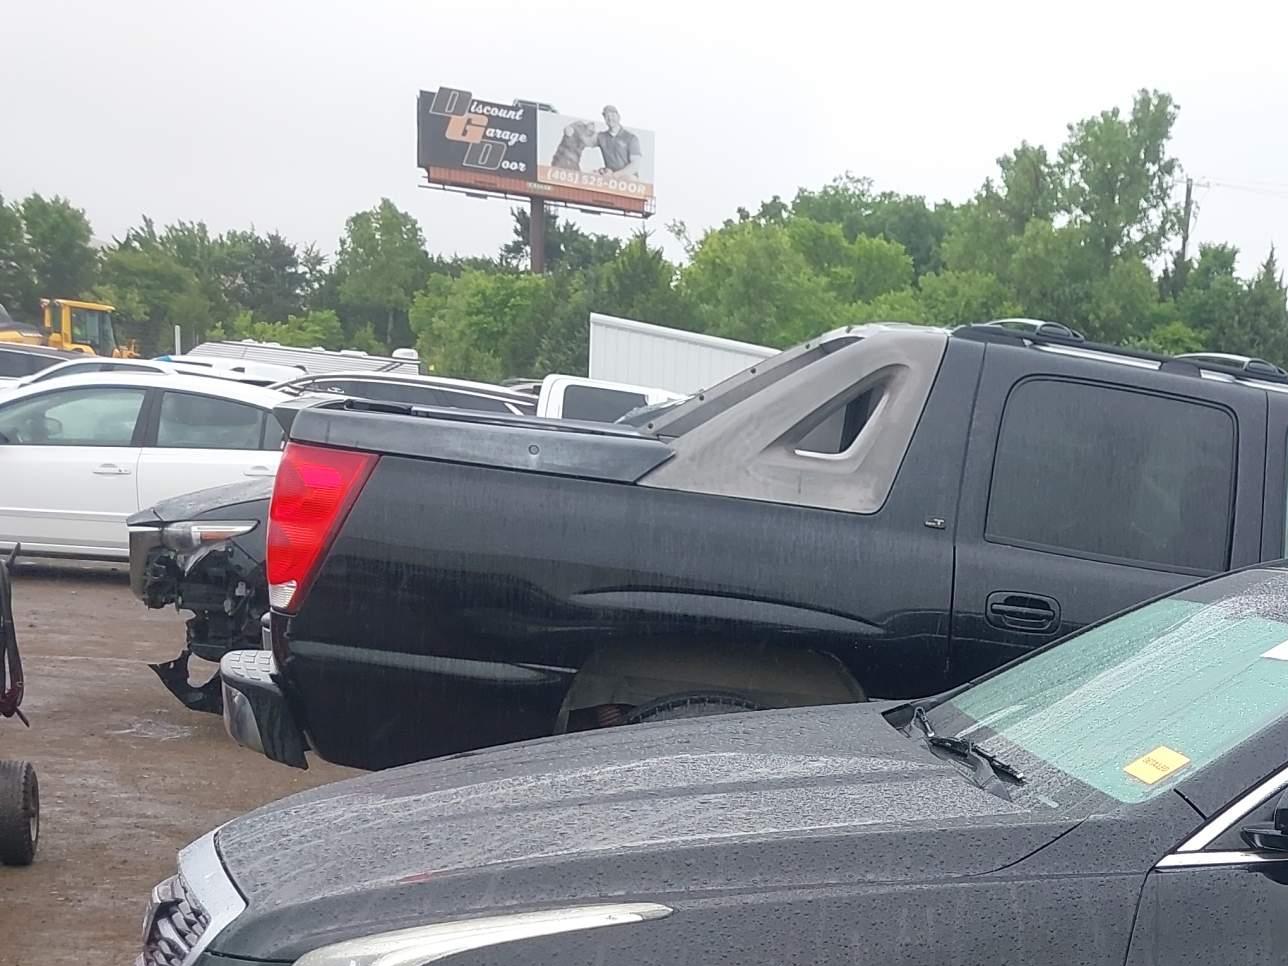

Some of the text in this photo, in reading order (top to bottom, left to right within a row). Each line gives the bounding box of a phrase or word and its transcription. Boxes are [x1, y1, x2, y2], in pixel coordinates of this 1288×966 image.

[429, 87, 525, 121] Discount
[445, 114, 528, 145] Garage
[463, 140, 527, 172] Door
[546, 169, 580, 186] (405)
